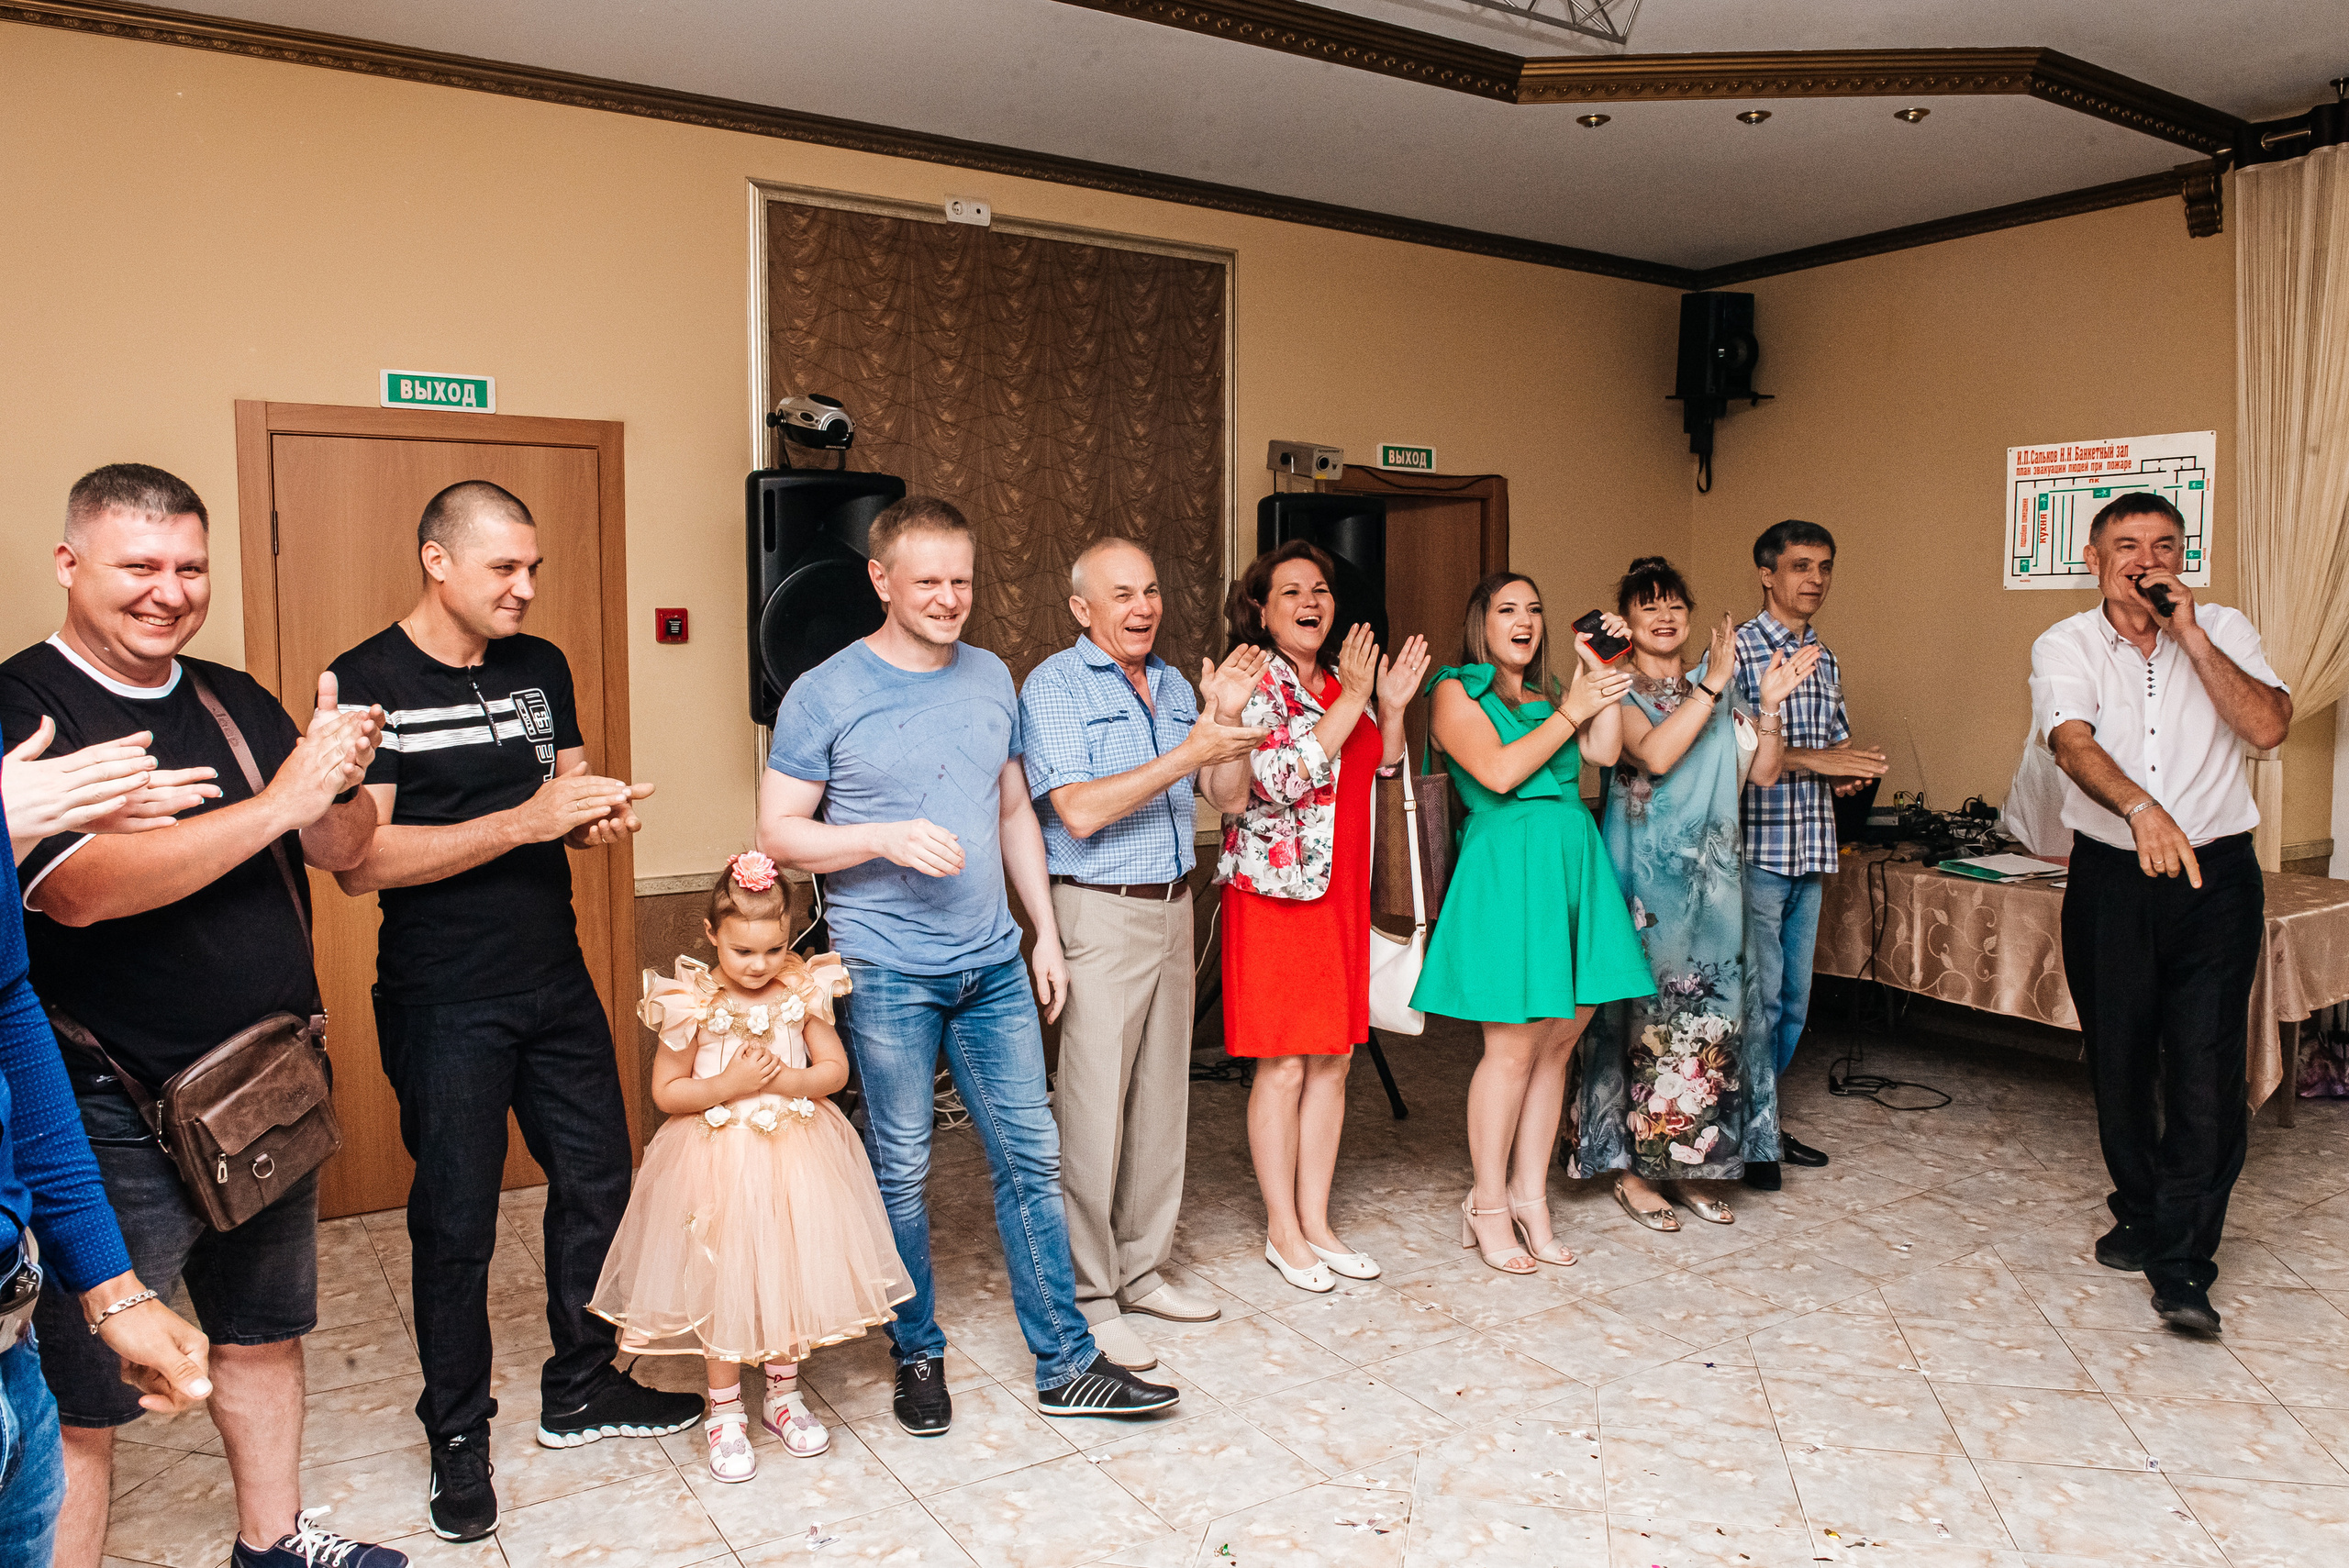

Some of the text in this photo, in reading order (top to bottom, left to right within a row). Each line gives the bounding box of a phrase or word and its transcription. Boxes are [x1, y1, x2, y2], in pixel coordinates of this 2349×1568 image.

[400, 379, 476, 407] ВЫХОД
[1388, 450, 1427, 469] ВЫХОД
[2116, 445, 2129, 458] зал
[2016, 467, 2031, 476] план
[2068, 462, 2088, 473] людей
[2091, 462, 2102, 473] при
[2107, 460, 2132, 471] пожаре
[2040, 514, 2049, 544] кухня
